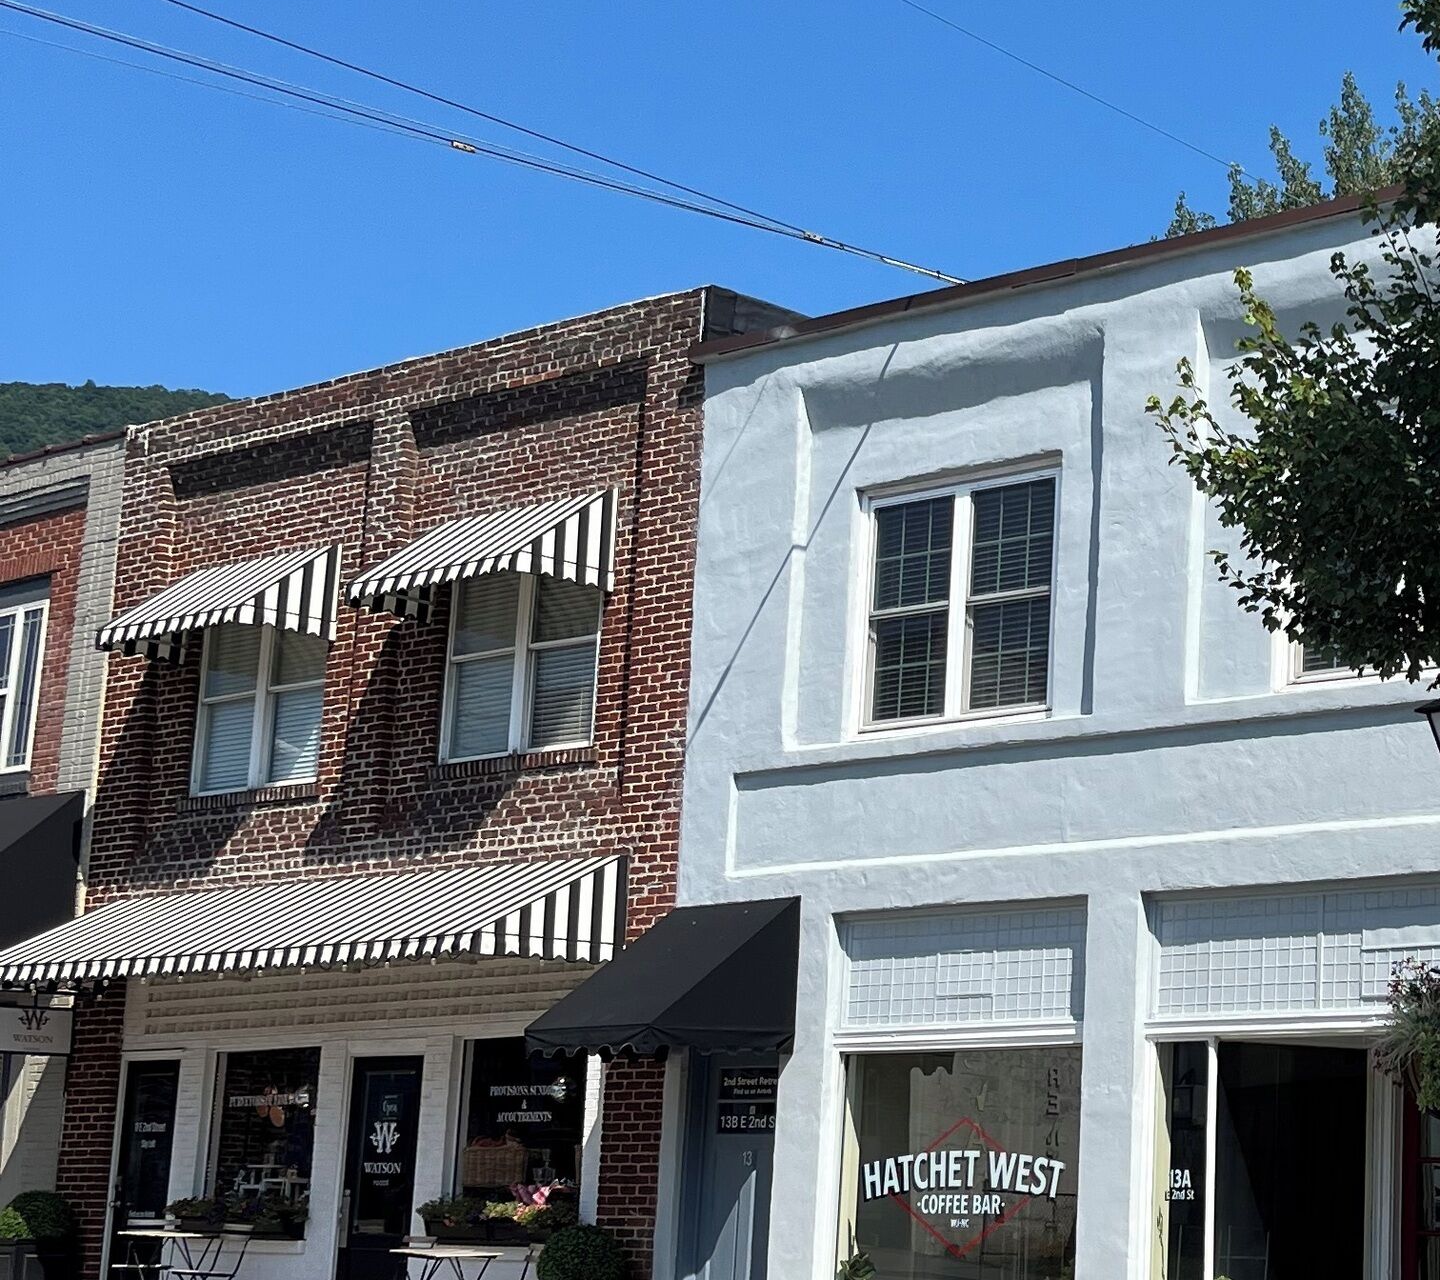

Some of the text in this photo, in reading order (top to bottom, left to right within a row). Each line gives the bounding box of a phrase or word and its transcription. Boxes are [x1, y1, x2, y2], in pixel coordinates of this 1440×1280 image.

[13, 1034, 53, 1044] WATSON
[723, 1077, 736, 1086] 2nd
[737, 1076, 758, 1086] Street
[720, 1115, 776, 1128] 13B E 2nd S
[742, 1151, 753, 1166] 13
[363, 1162, 402, 1174] WATSON
[863, 1150, 1066, 1200] HATCHET WEST
[1170, 1169, 1192, 1188] 13A
[1171, 1189, 1186, 1200] 2nd
[1186, 1189, 1195, 1200] St
